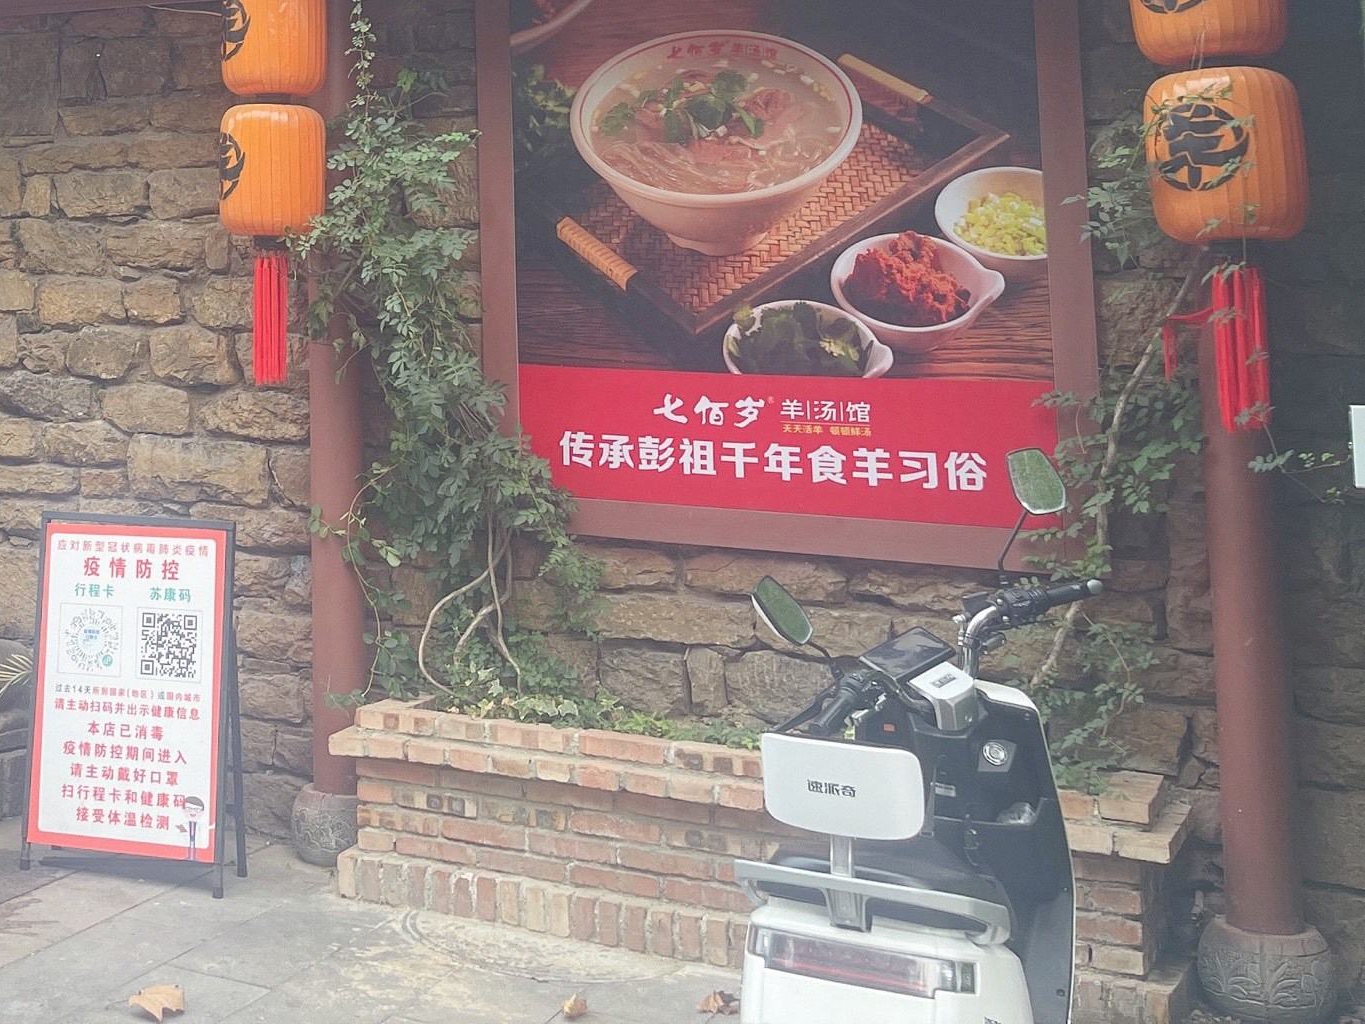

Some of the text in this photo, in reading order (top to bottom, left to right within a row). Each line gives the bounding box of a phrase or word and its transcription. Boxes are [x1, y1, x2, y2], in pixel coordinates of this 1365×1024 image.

[653, 393, 765, 428] 七佰岁
[782, 425, 872, 437] 天天活羊 顿顿鲜汤
[559, 430, 988, 493] 传承彭祖千年食羊习俗
[57, 540, 209, 557] 应对新型冠状病毒肺炎疫情
[83, 556, 180, 581] 疫情防控
[74, 583, 192, 603] 行程卡 苏康码
[87, 721, 164, 741] 本店已消毒
[63, 740, 188, 764] 疫情防控期间进入
[70, 763, 179, 786] 请主动戴好口罩
[61, 784, 187, 809] 扫行程卡和健康码
[807, 779, 857, 797] 速派奇
[76, 806, 170, 830] 接受体温检测
